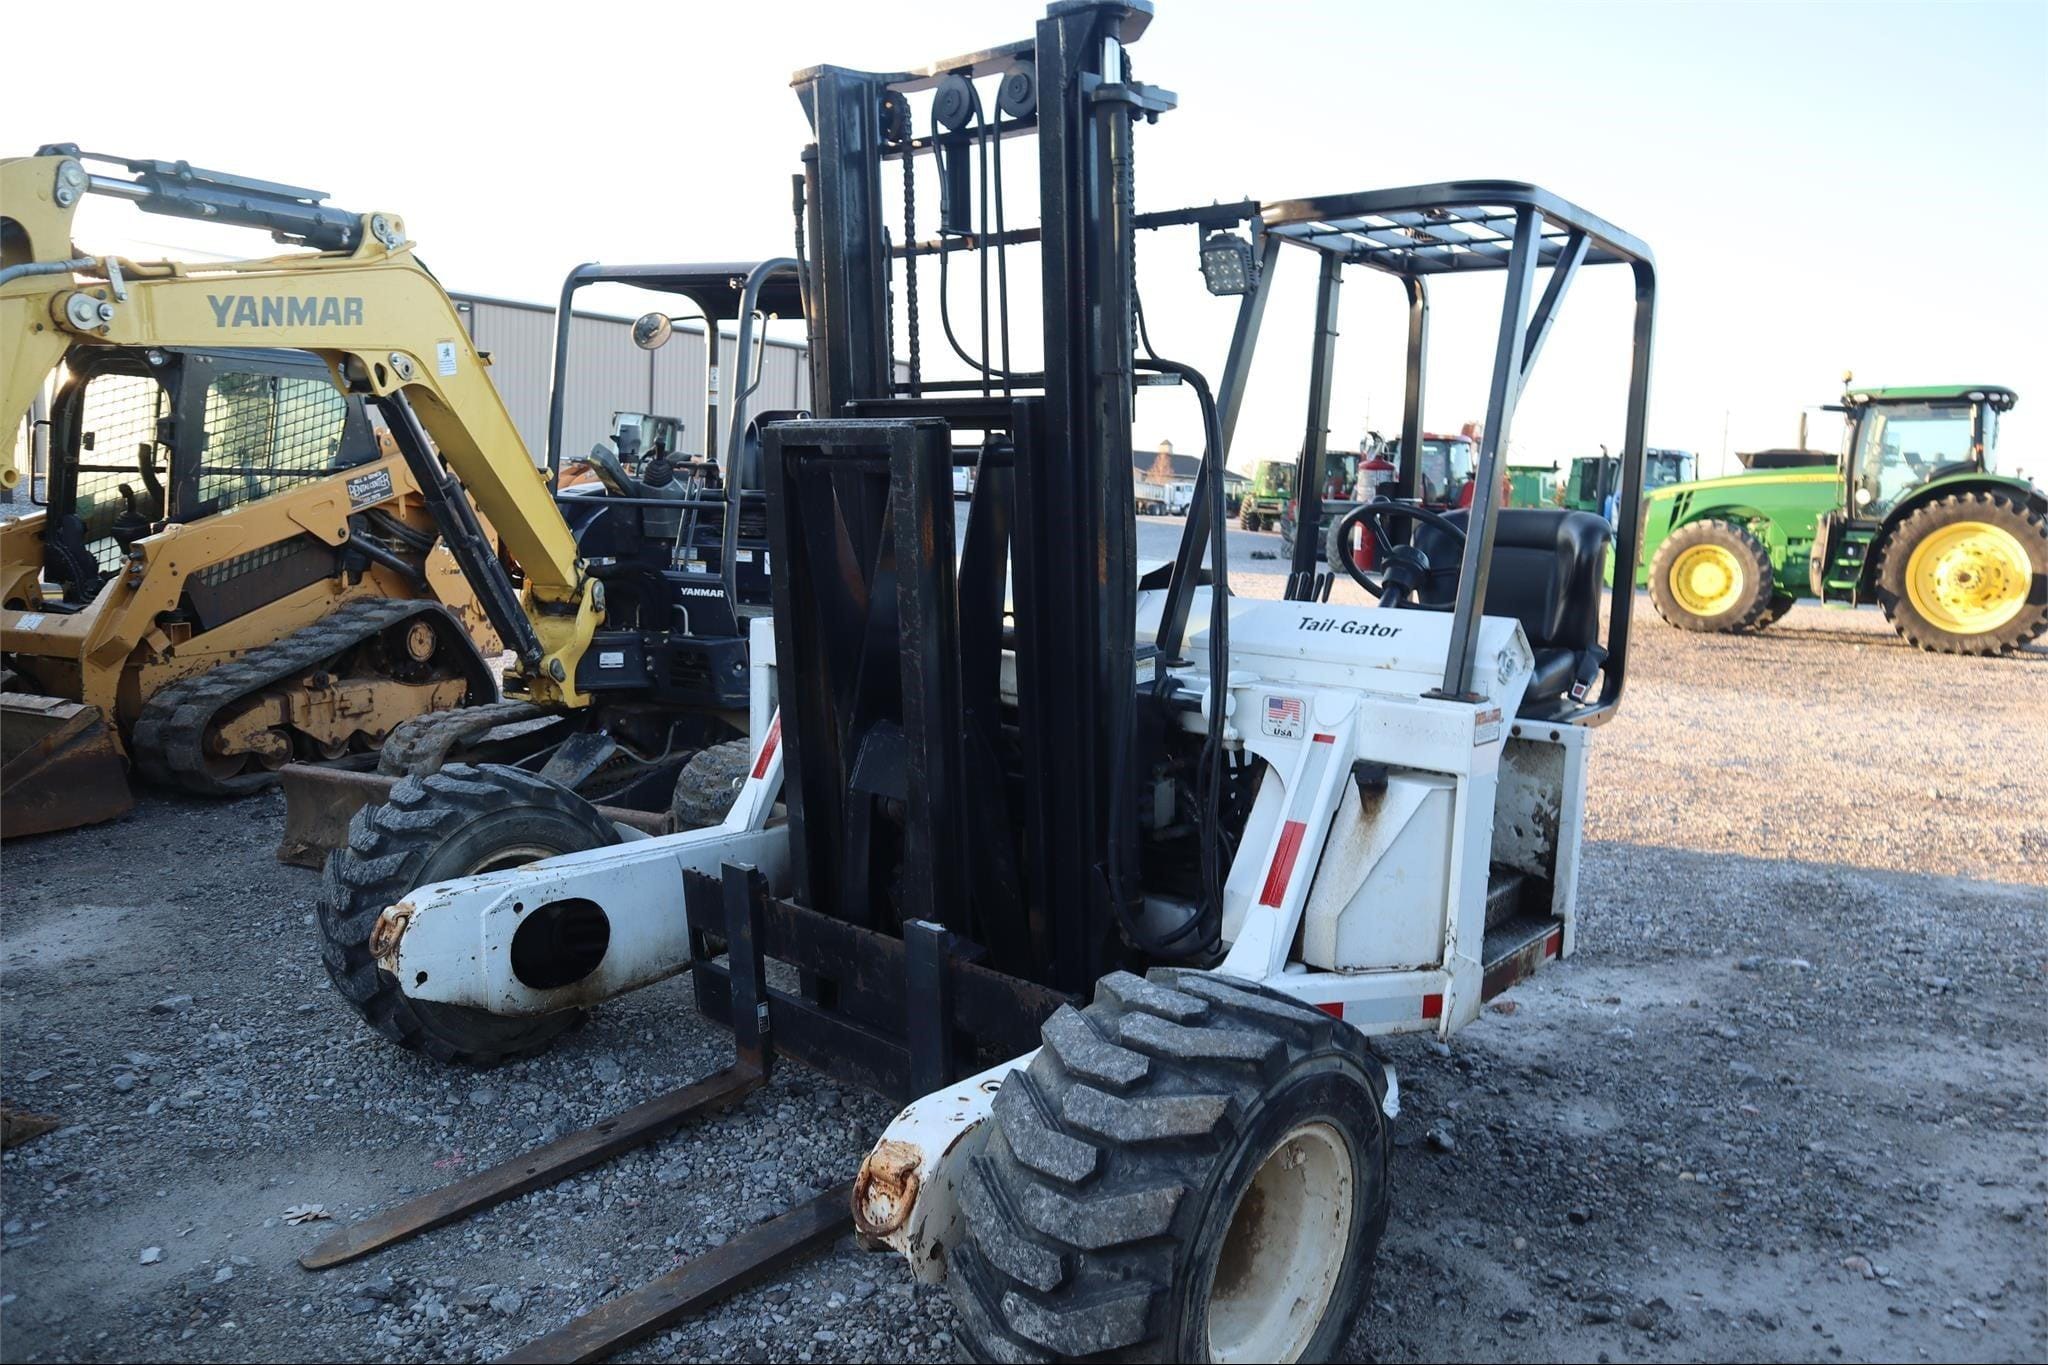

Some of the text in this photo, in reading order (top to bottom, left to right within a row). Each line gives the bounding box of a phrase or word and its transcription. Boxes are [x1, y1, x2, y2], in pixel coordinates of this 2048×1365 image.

[207, 295, 364, 328] YANMAR
[681, 588, 724, 598] YANMAR
[1298, 617, 1402, 638] Tail-Gator
[1273, 728, 1292, 737] USA
